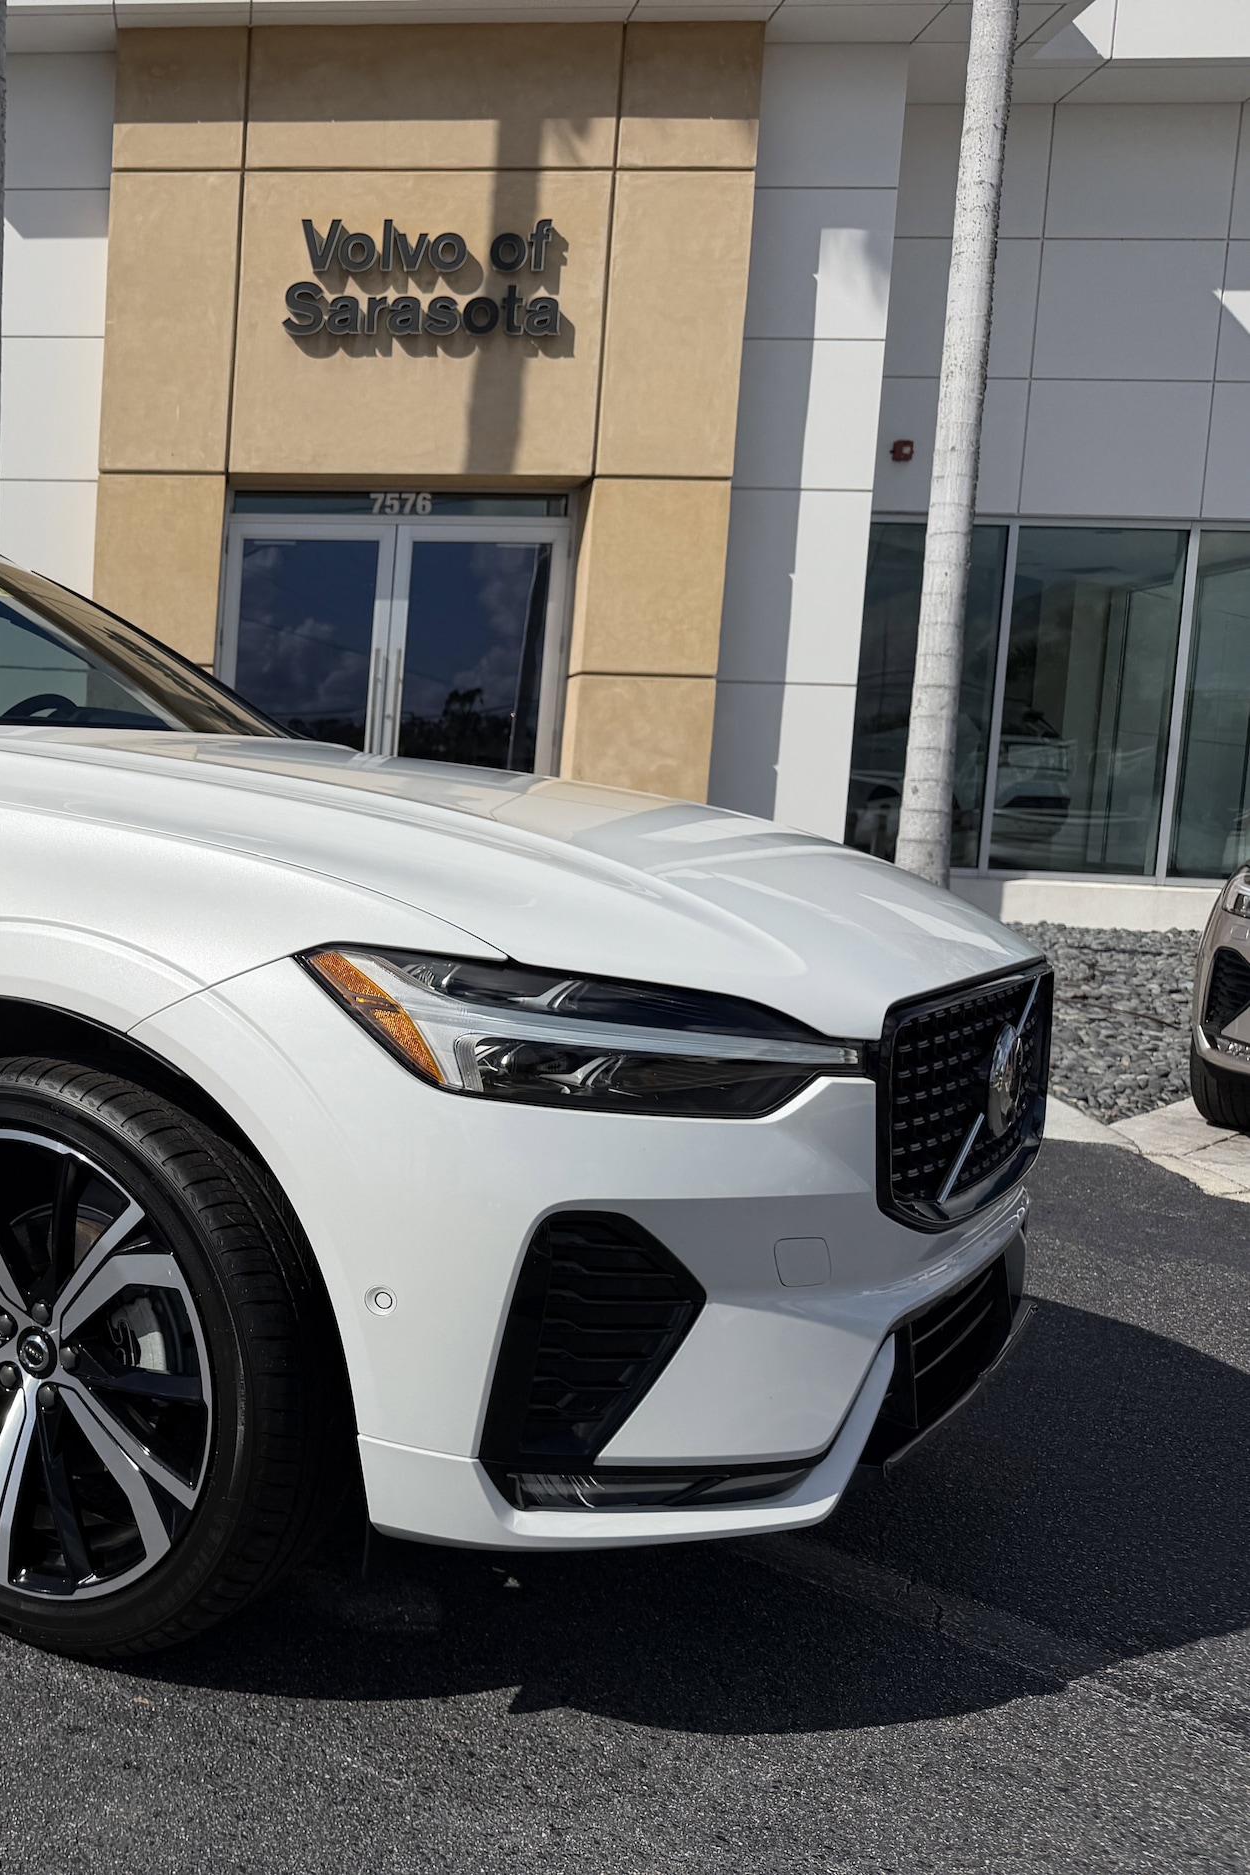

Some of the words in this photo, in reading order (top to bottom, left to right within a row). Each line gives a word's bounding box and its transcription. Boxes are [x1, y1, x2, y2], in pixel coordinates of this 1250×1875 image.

[301, 218, 469, 273] Volvo
[489, 218, 553, 273] of
[281, 281, 561, 336] Sarasota
[369, 492, 433, 516] 7576
